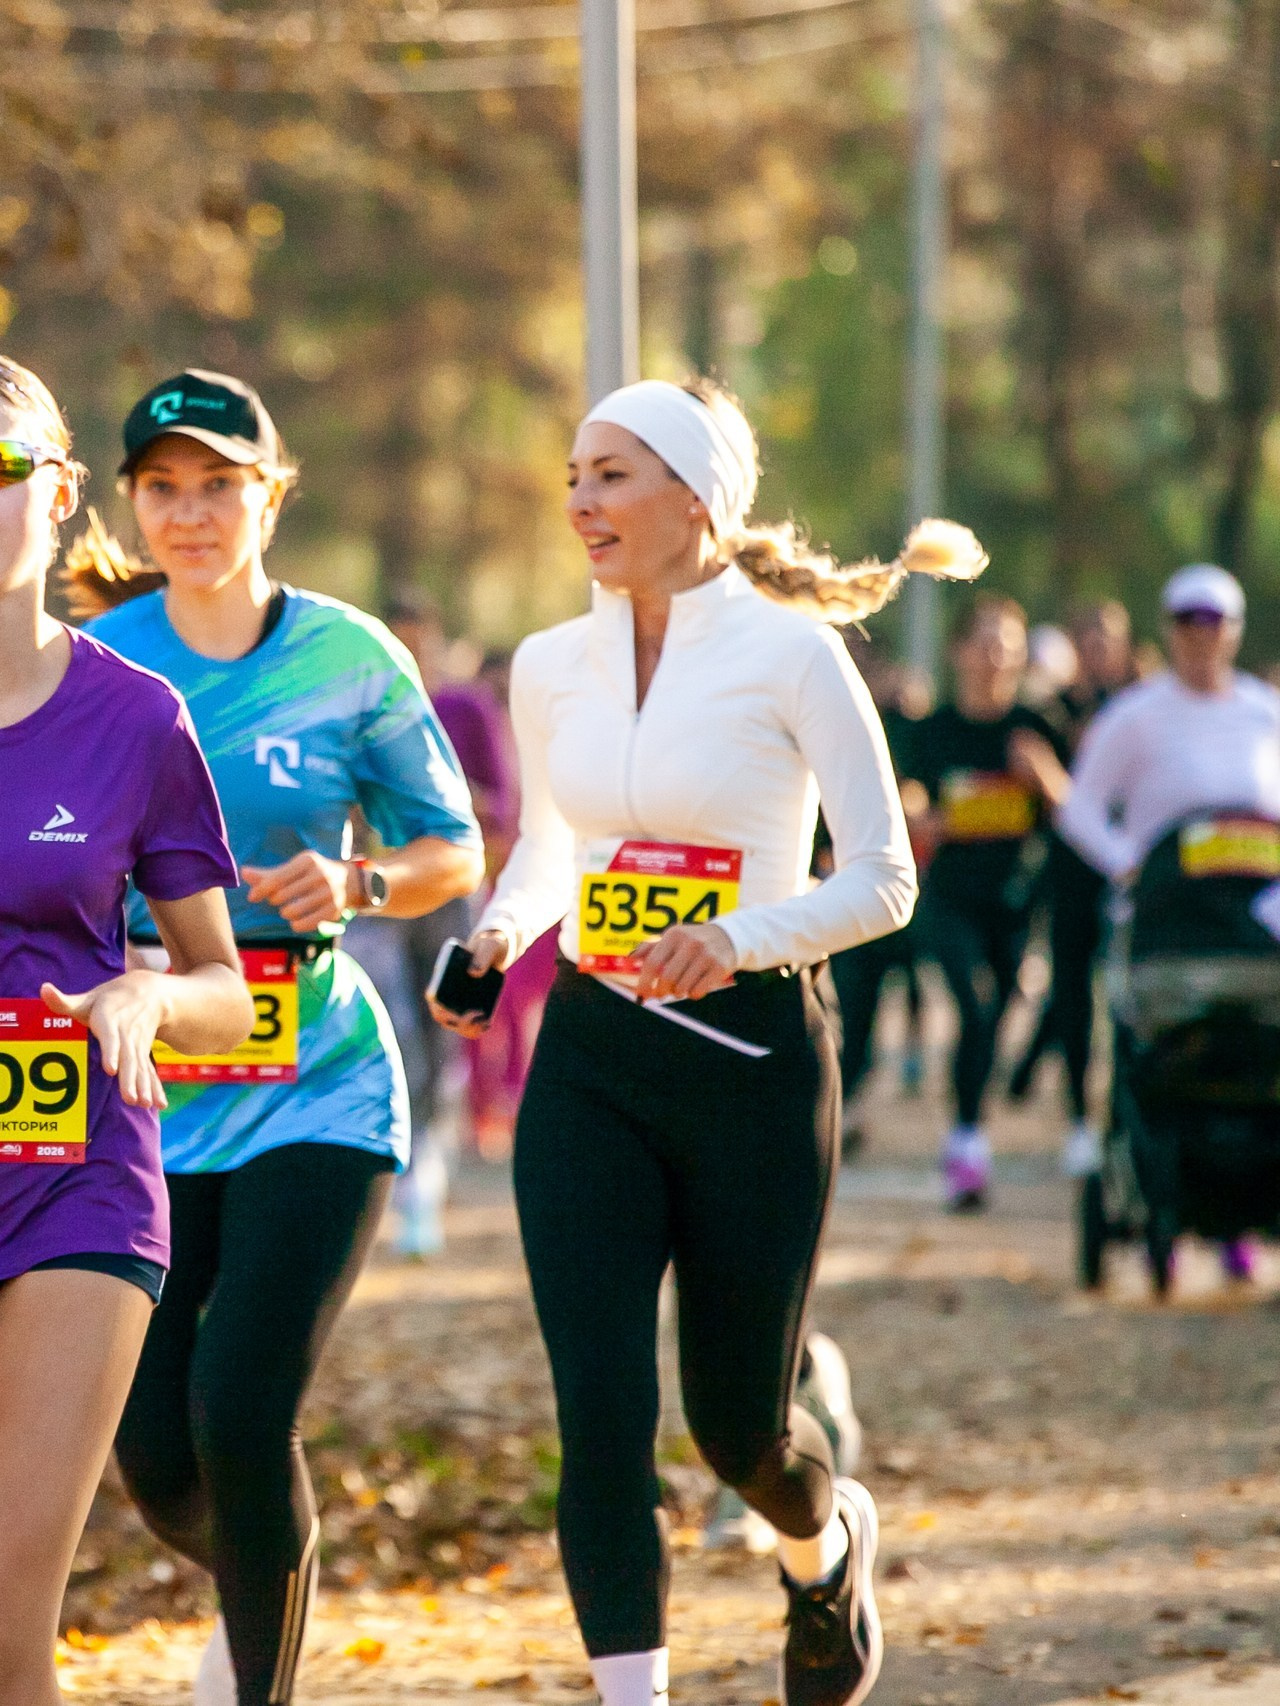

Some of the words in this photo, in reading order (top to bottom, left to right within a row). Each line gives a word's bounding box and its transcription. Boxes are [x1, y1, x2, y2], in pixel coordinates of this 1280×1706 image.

[28, 831, 88, 843] DEMIX
[585, 882, 721, 934] 5354
[43, 1018, 52, 1028] 5
